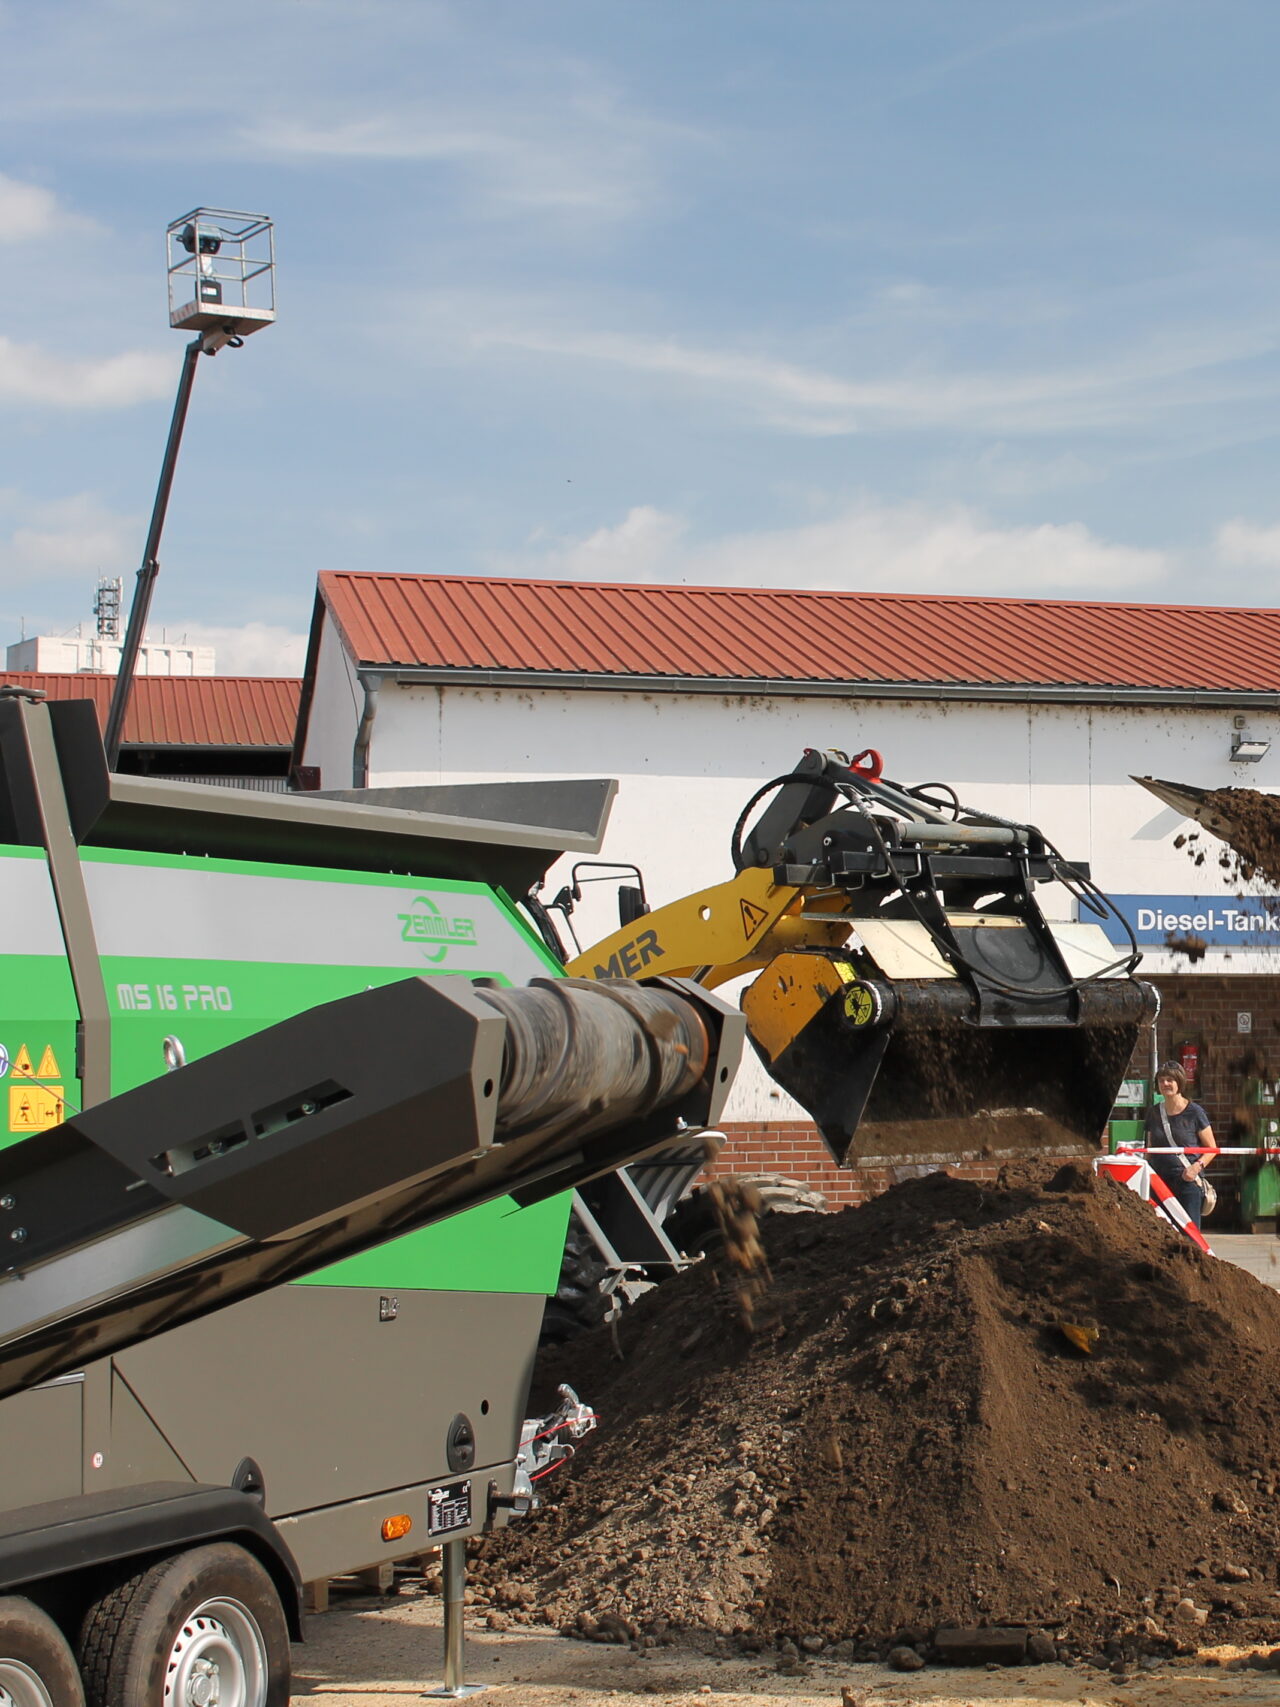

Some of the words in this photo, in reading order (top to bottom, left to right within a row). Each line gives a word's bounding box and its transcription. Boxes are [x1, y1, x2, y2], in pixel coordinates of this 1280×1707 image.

[396, 913, 478, 946] ZEMMLER
[580, 929, 666, 979] MER
[117, 983, 152, 1010] MS
[156, 984, 178, 1010] 16
[182, 984, 233, 1011] PRO
